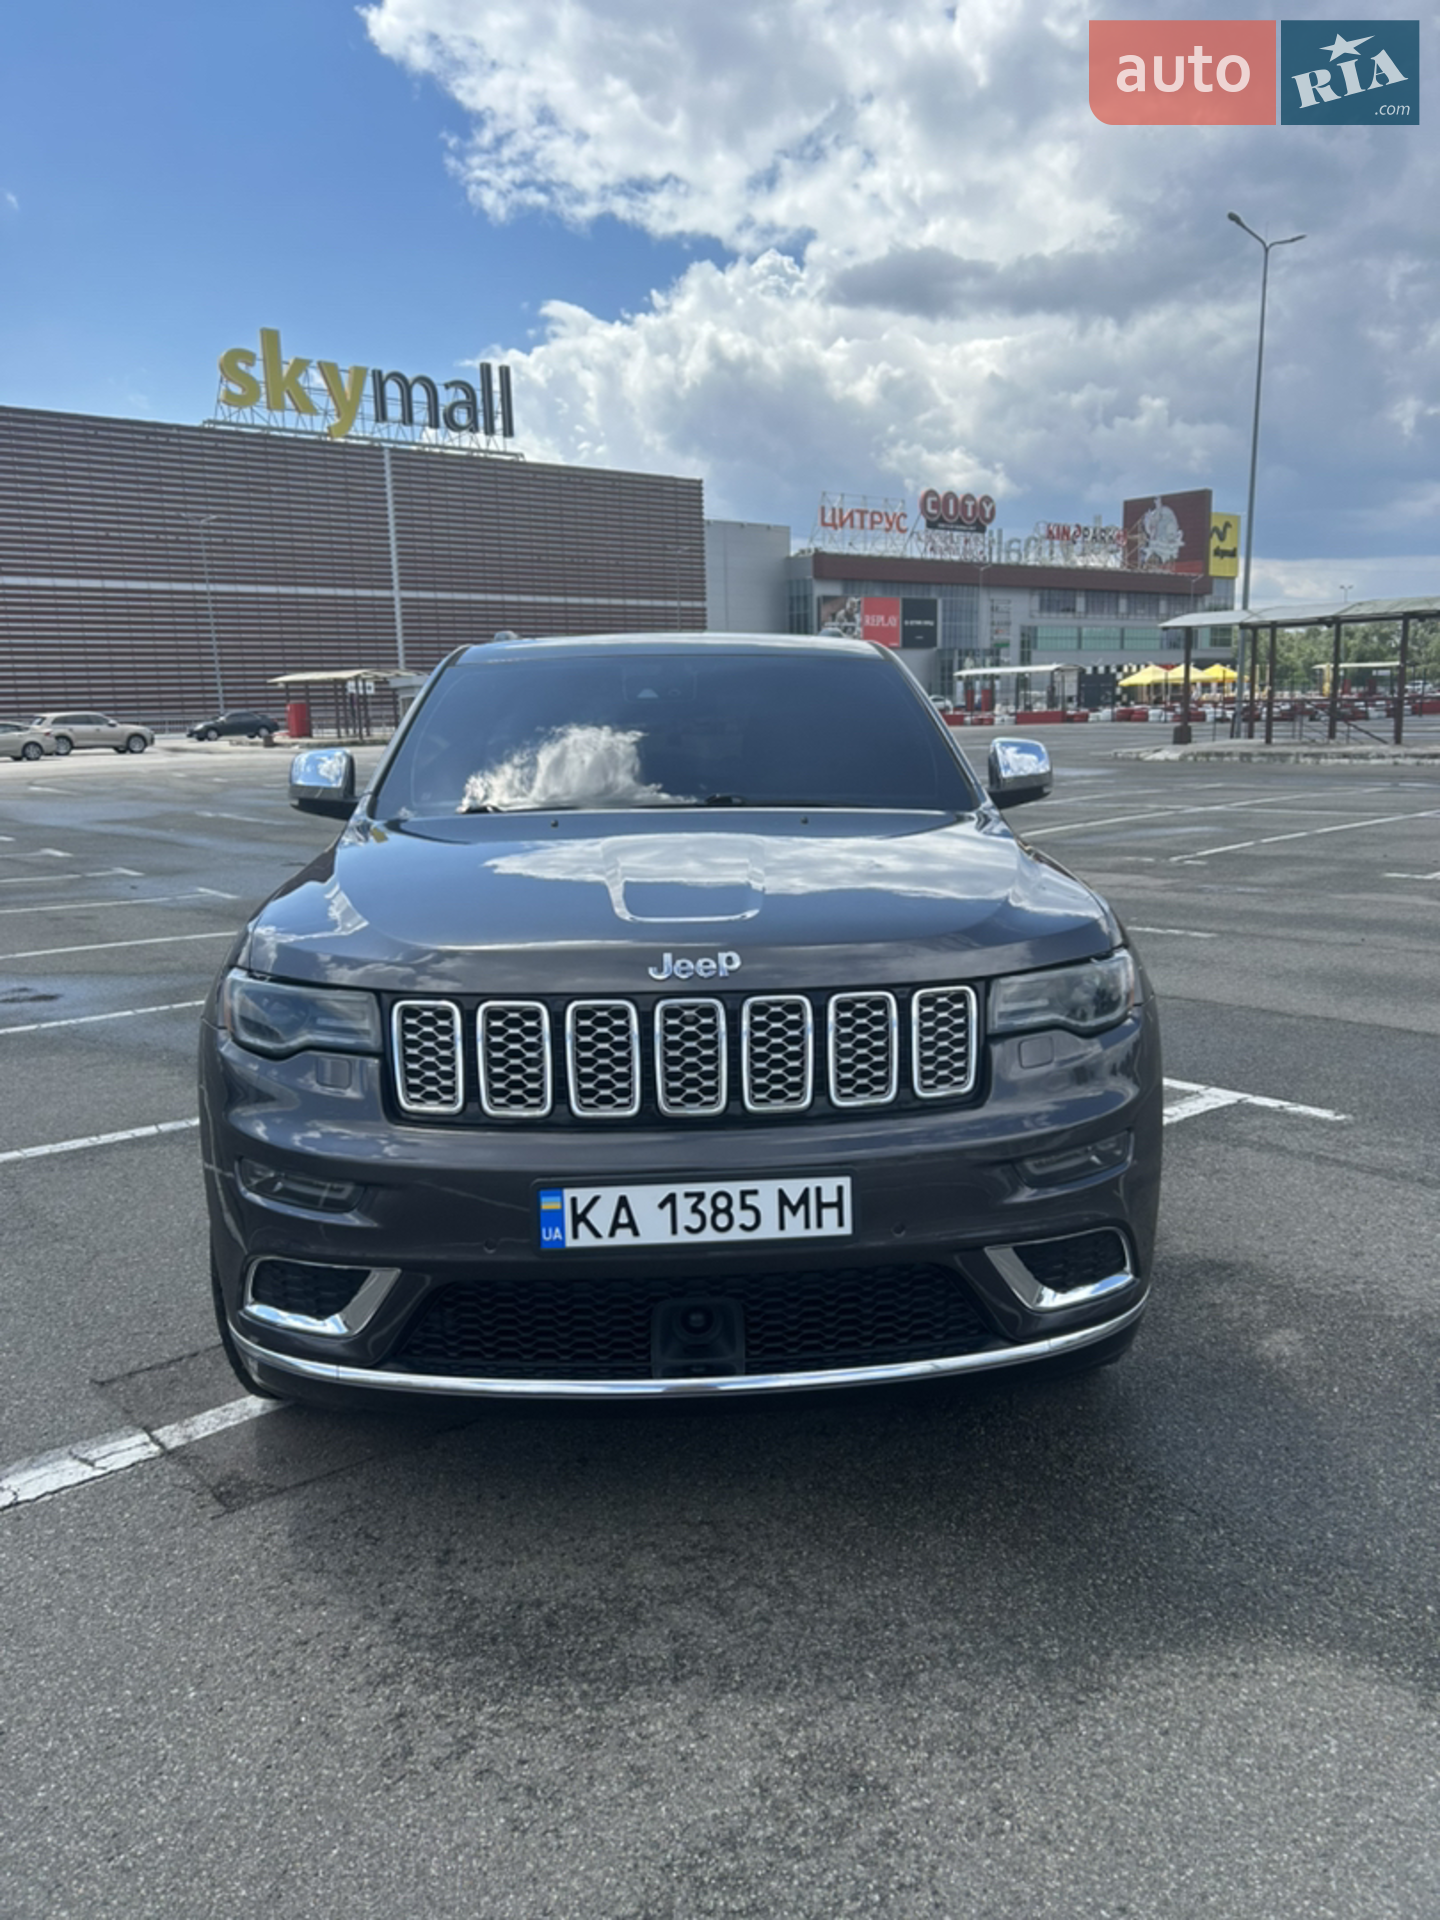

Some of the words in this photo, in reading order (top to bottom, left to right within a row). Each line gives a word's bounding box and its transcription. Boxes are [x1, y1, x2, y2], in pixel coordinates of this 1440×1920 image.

[218, 327, 514, 440] skymall
[820, 505, 908, 533] ЦИТРУС
[924, 492, 994, 522] CITY
[863, 614, 897, 627] REPLAY
[648, 950, 742, 980] Jeep
[569, 1194, 640, 1240] KA
[657, 1188, 762, 1236] 1385
[777, 1184, 846, 1231] MH
[542, 1227, 563, 1242] UA
